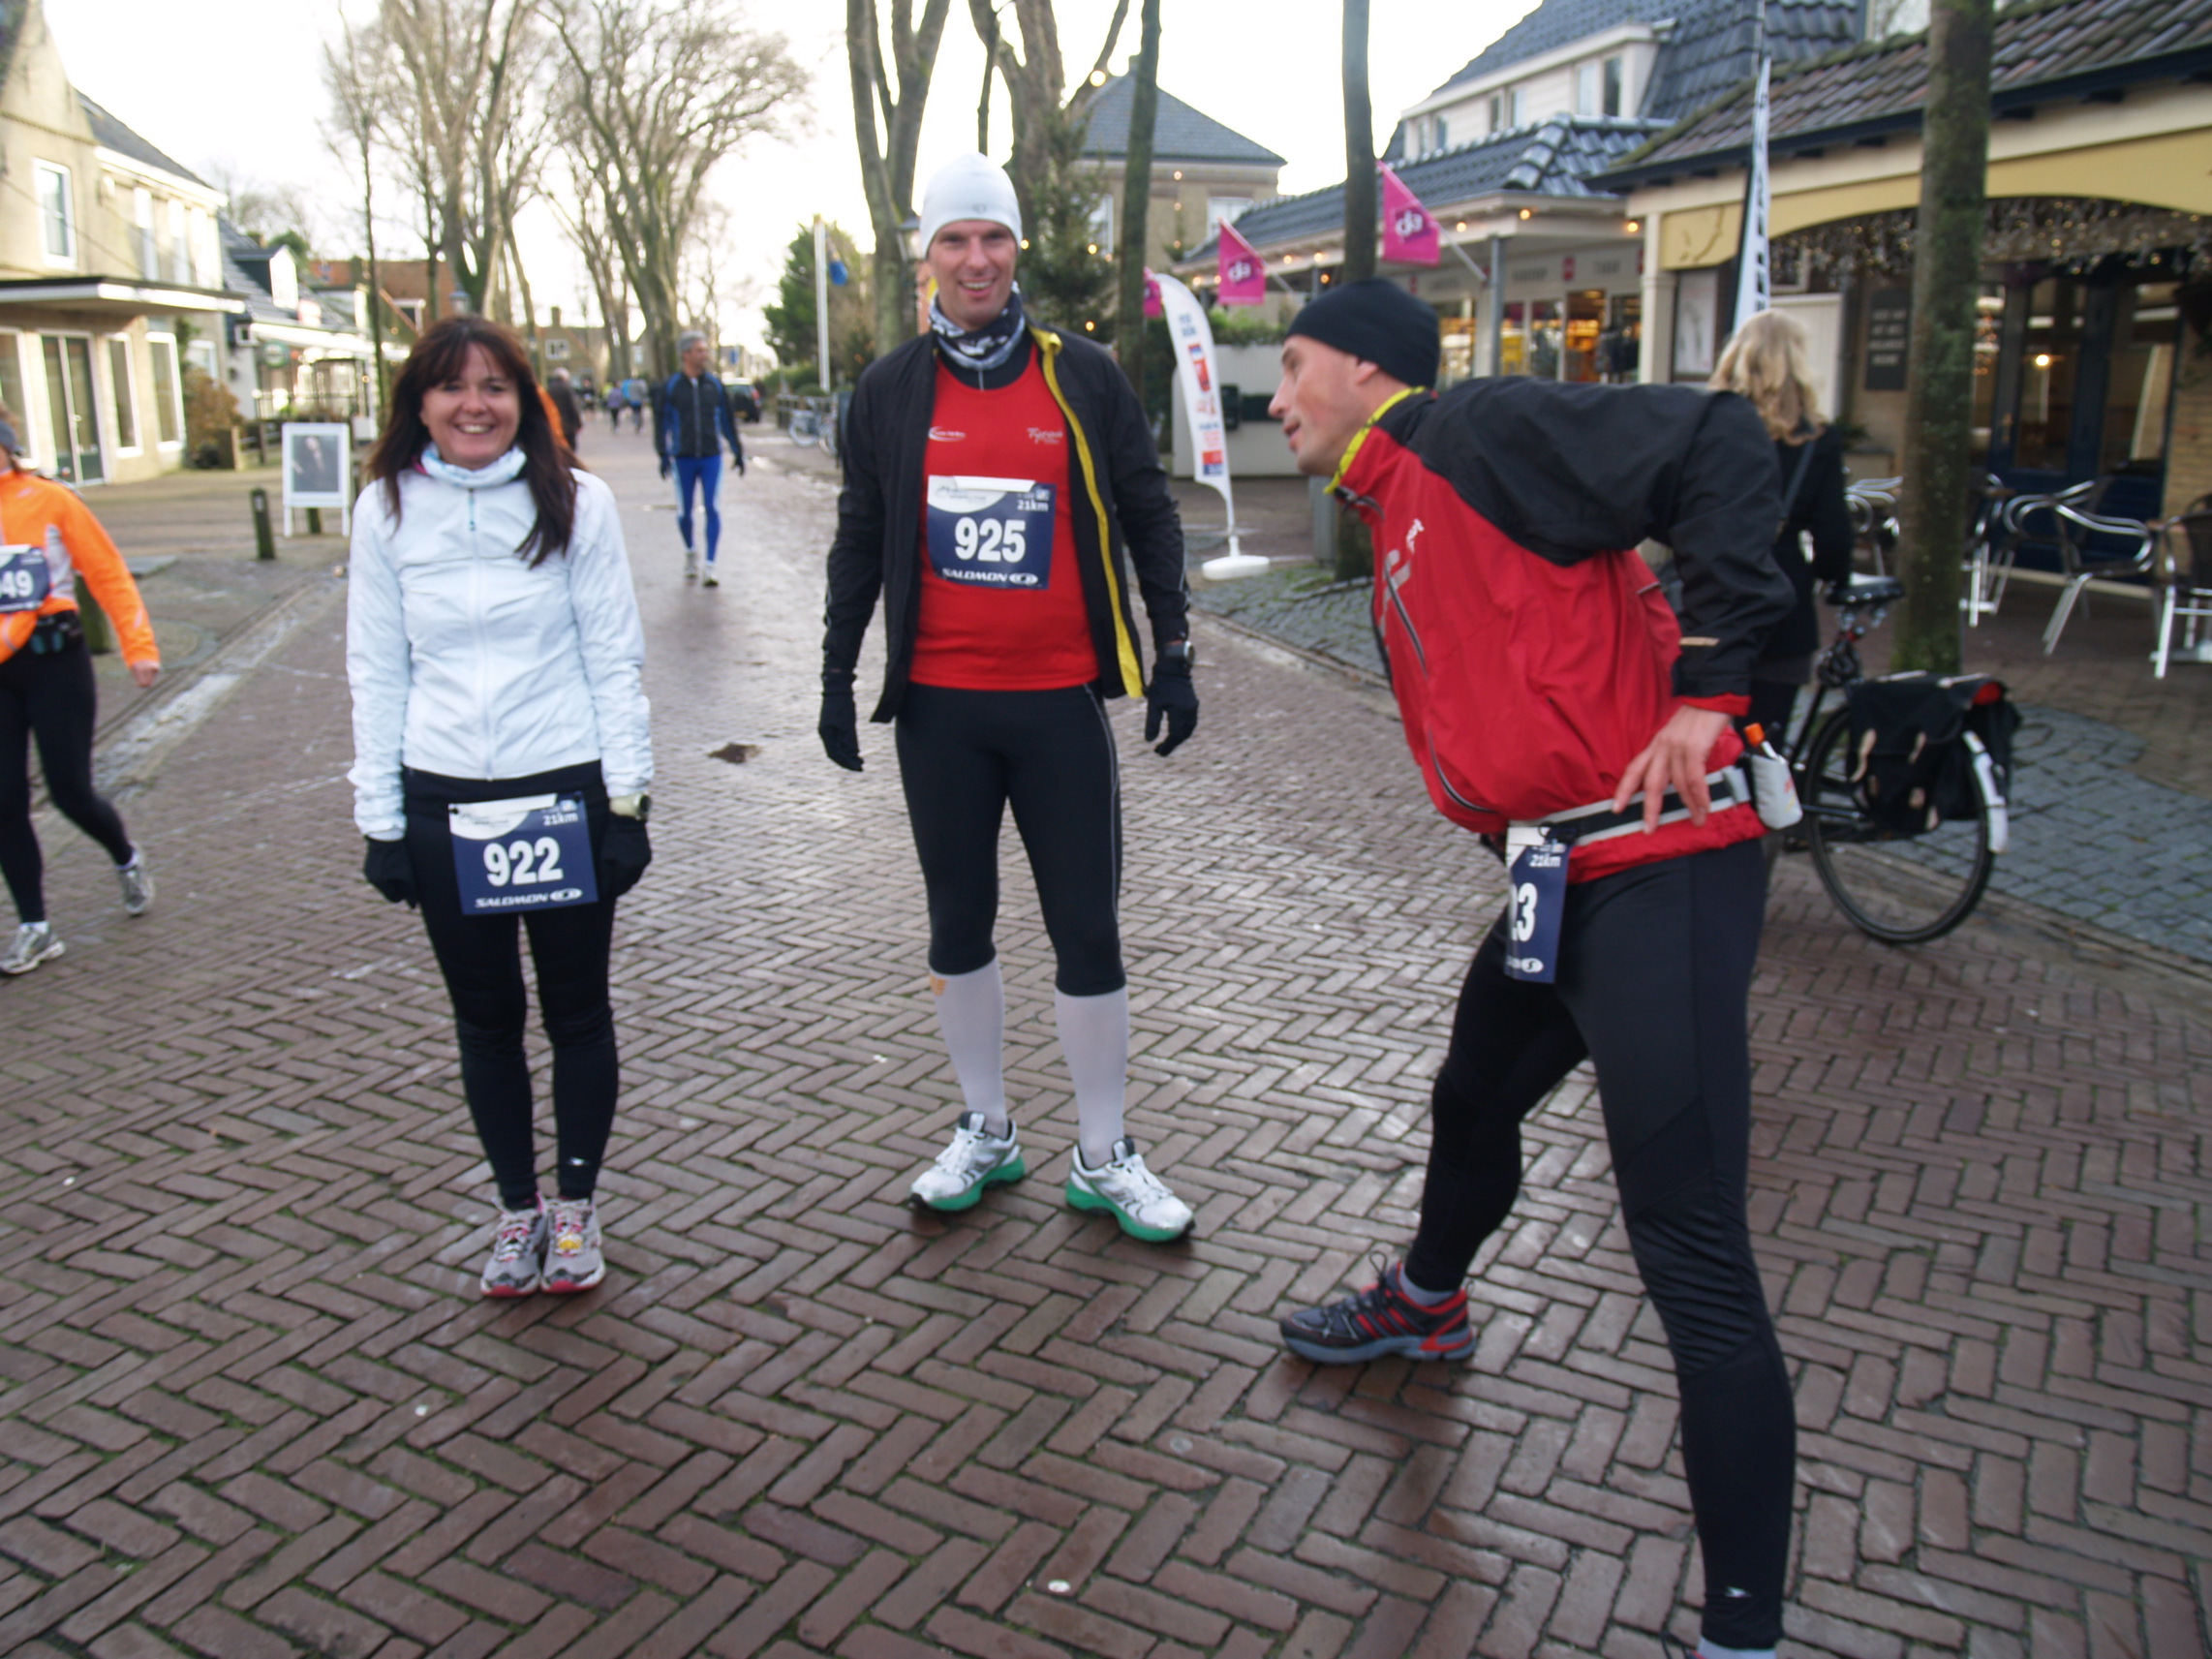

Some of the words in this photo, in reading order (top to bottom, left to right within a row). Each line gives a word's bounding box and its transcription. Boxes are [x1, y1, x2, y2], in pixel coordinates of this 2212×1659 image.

[1395, 210, 1424, 236] da
[1017, 500, 1049, 511] 21km
[954, 516, 1026, 563] 925
[941, 568, 1007, 582] SALOMON
[0, 569, 33, 599] 49
[543, 812, 578, 826] 21km
[483, 836, 564, 887] 922
[1528, 853, 1561, 868] 21km
[475, 892, 549, 908] SALOMON
